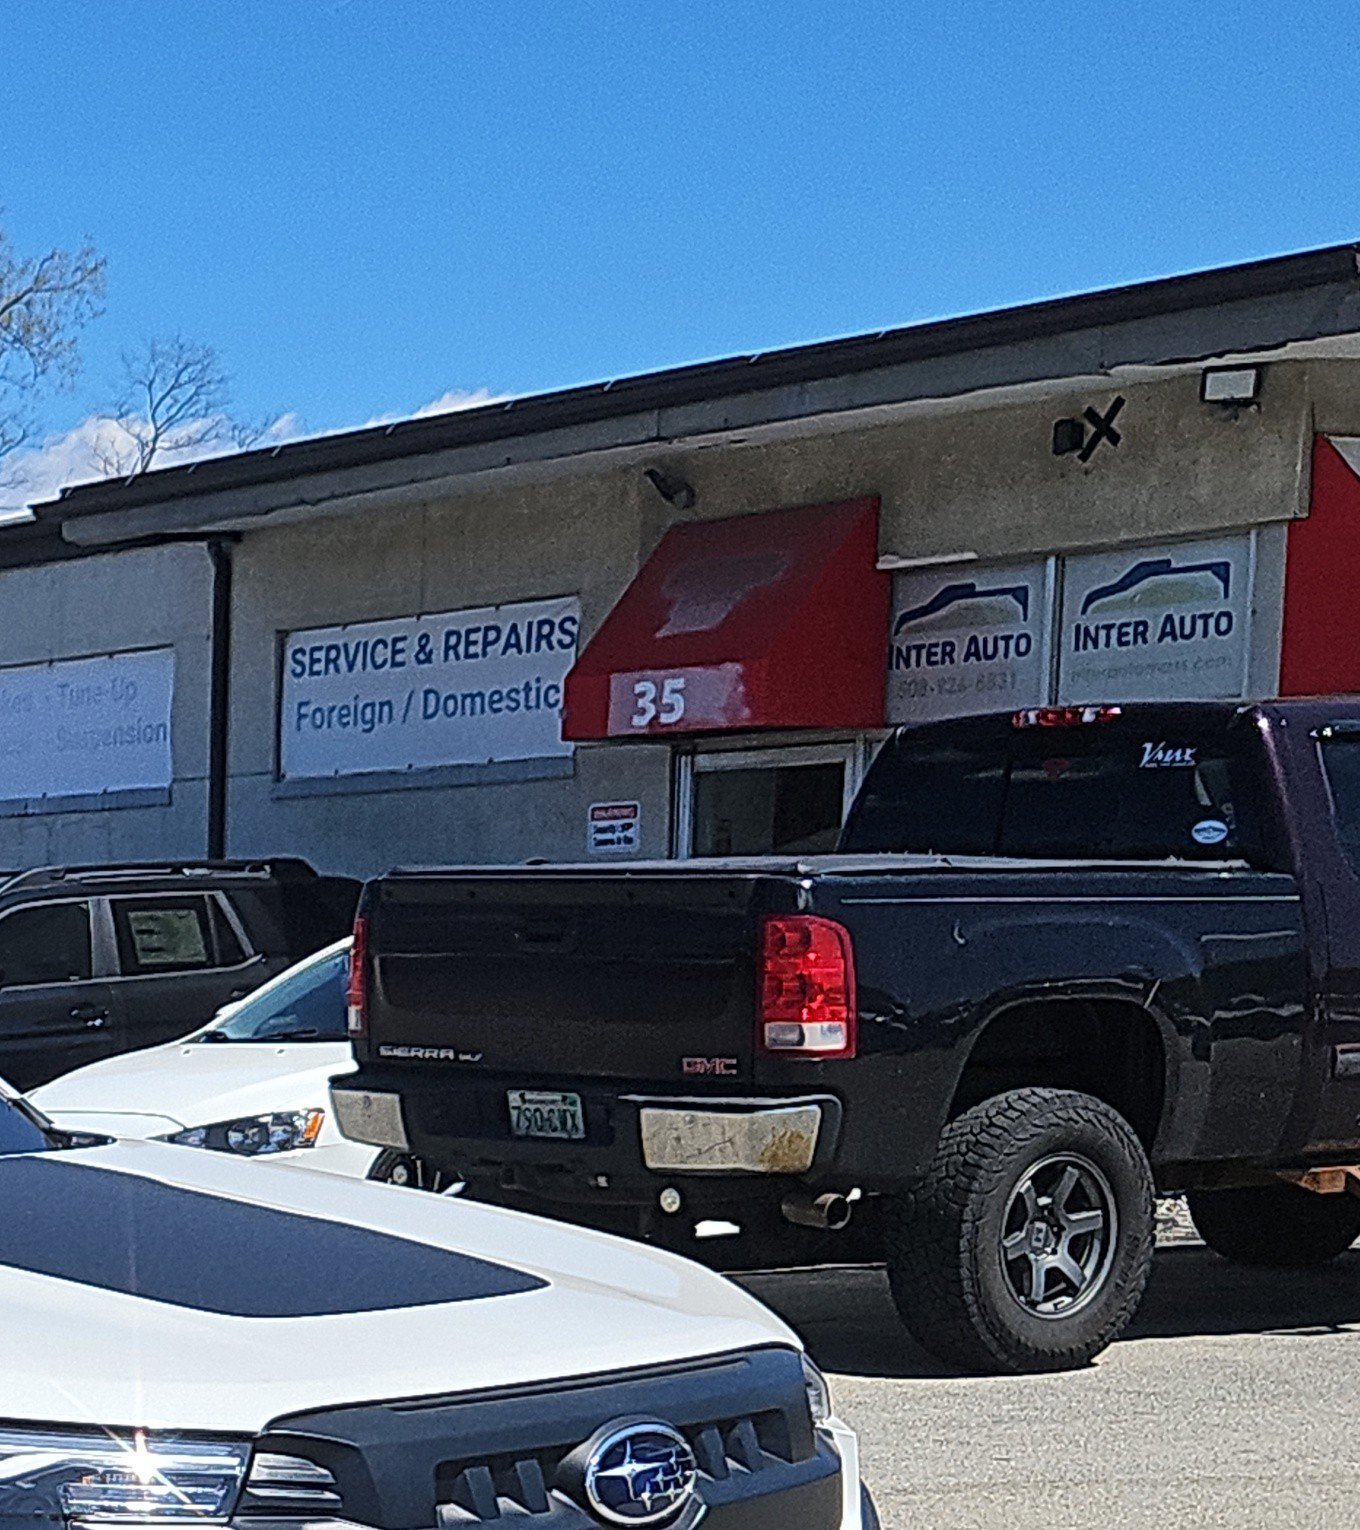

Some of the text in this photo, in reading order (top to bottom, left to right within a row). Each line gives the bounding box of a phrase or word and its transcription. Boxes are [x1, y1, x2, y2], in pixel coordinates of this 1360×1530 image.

[290, 615, 578, 679] SERVICE & REPAIRS
[888, 632, 1032, 670] INTER AUTO
[1074, 610, 1233, 652] INTER AUTO
[295, 676, 561, 733] Foreign / Domestic
[631, 677, 685, 727] 35
[681, 1057, 738, 1075] GMC
